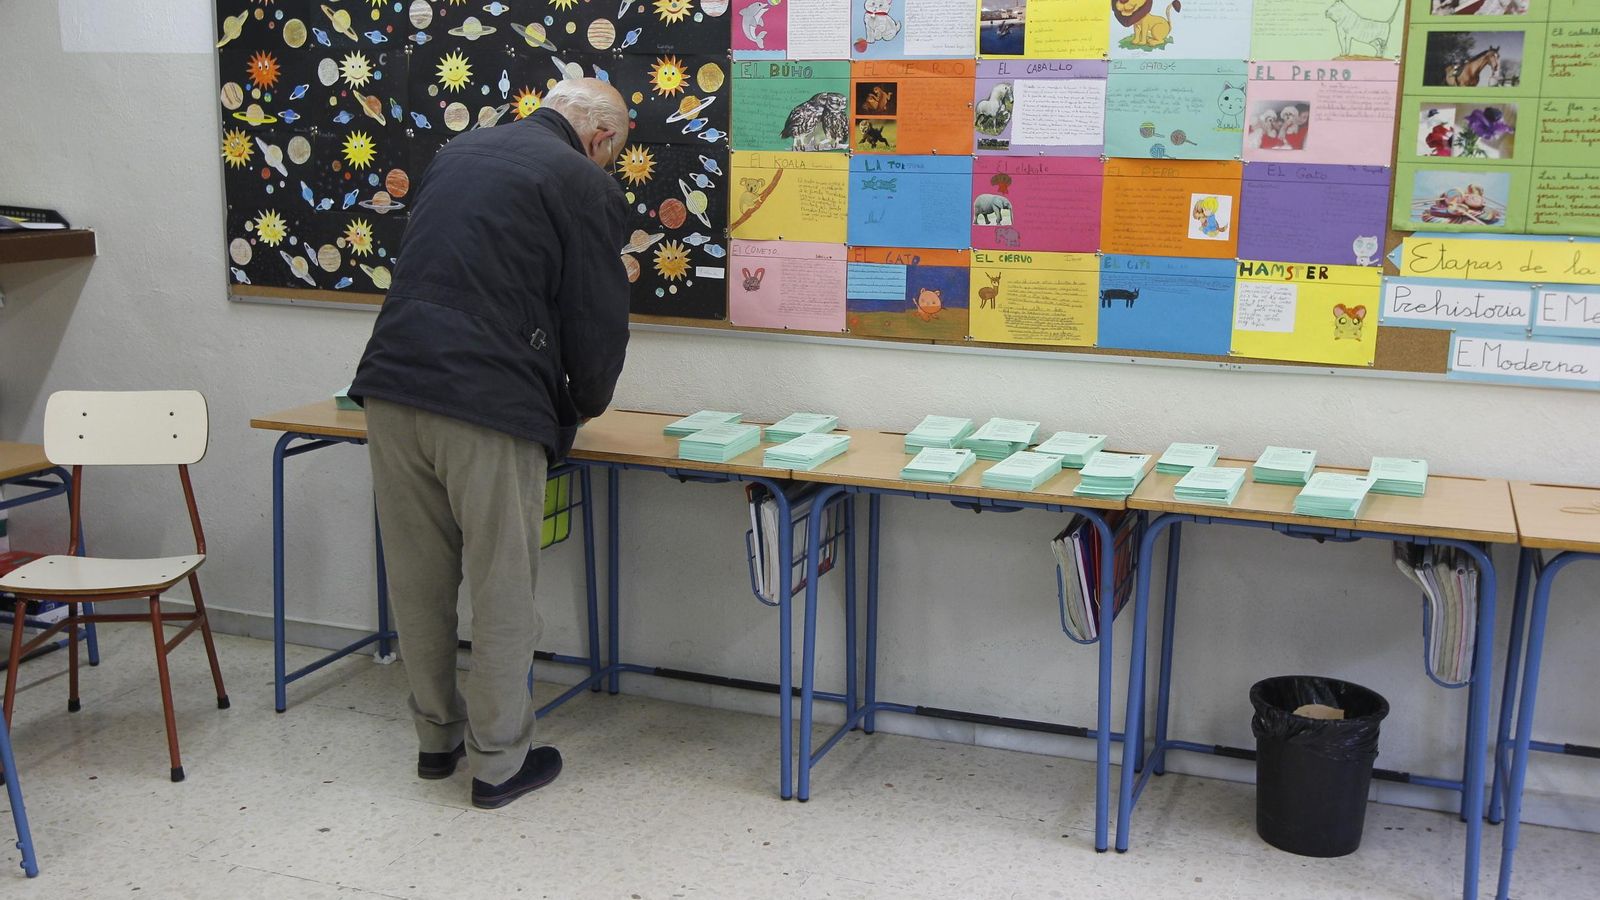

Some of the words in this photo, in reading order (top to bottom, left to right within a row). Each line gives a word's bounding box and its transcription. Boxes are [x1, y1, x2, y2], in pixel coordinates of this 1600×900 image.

[740, 62, 764, 79] EL
[769, 62, 814, 79] BÚHO
[863, 63, 882, 76] EL
[998, 62, 1010, 75] EL
[1026, 63, 1073, 75] CABALLO
[1256, 65, 1275, 80] EL
[1292, 65, 1352, 81] PERRO
[774, 155, 806, 169] KOALA
[1267, 164, 1286, 177] EL
[885, 251, 921, 266] GATO
[975, 253, 994, 263] EL
[999, 254, 1033, 264] CIERVO
[1409, 242, 1503, 280] Etapas
[1519, 250, 1548, 273] de
[1563, 250, 1596, 275] la
[1239, 262, 1329, 281] HAMSTER
[1392, 286, 1526, 319] Prehistoria
